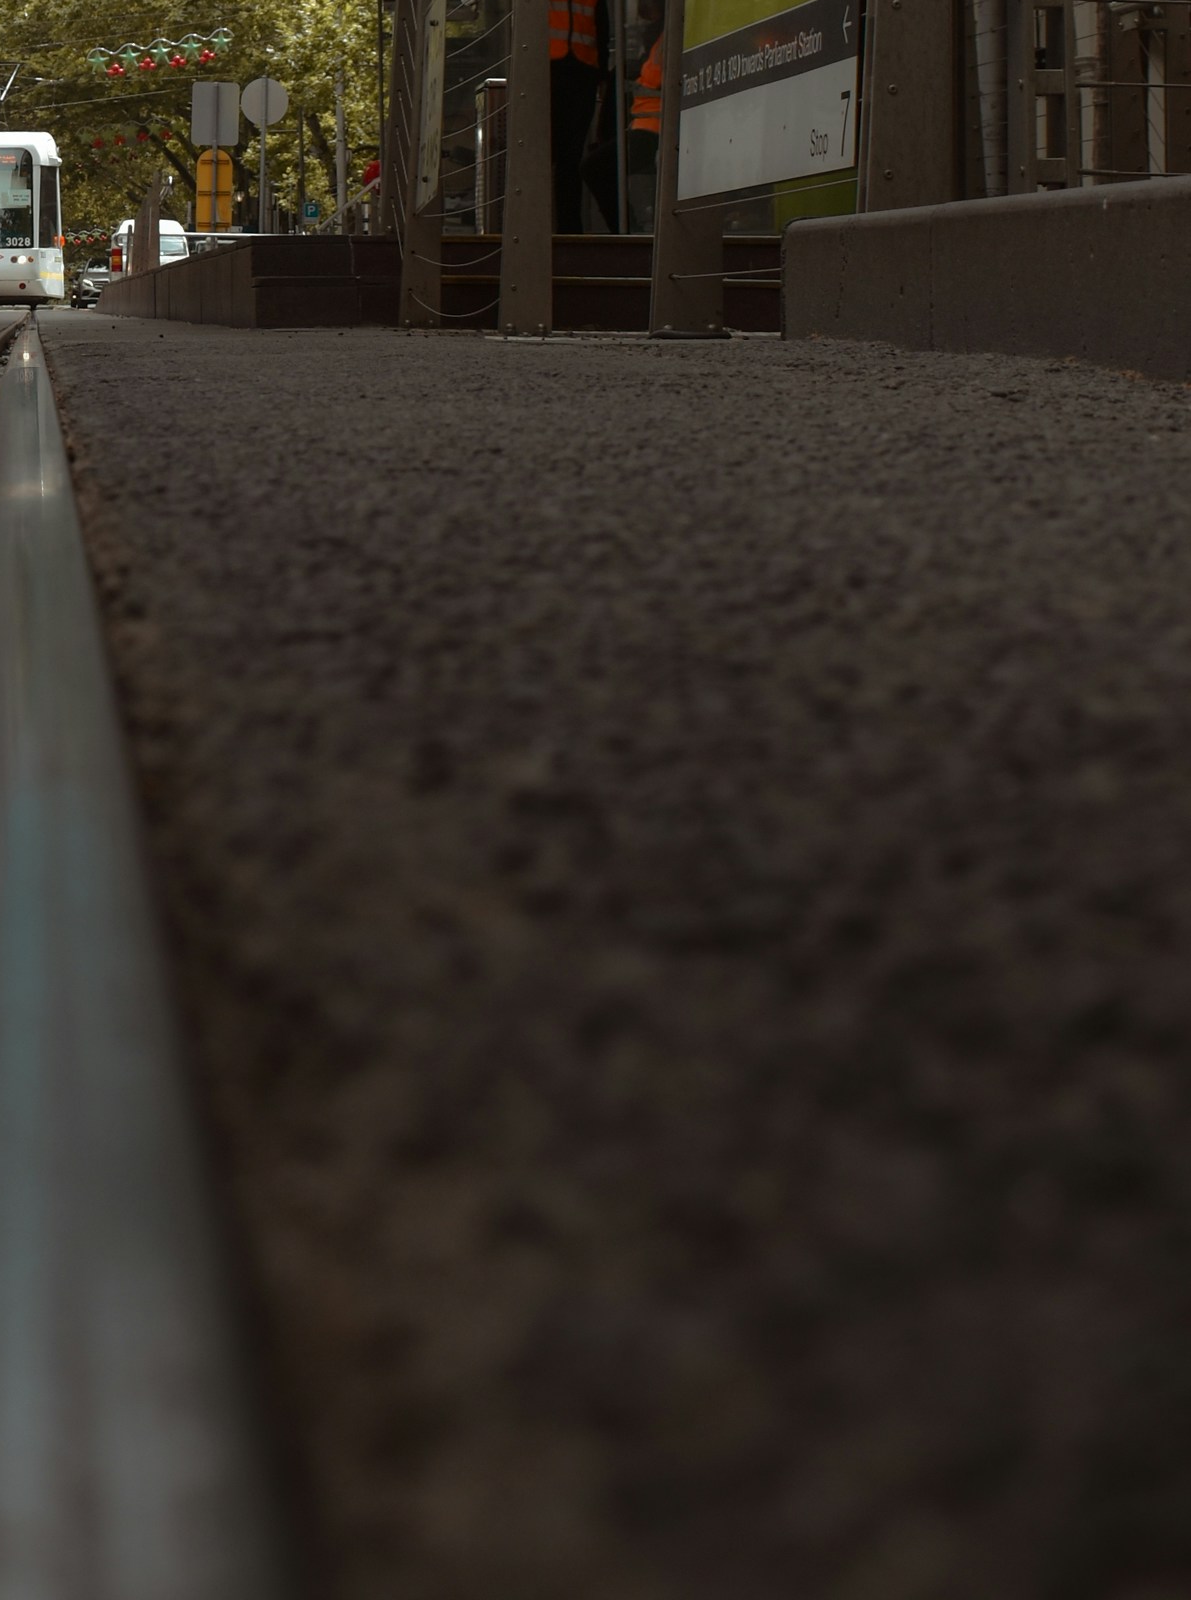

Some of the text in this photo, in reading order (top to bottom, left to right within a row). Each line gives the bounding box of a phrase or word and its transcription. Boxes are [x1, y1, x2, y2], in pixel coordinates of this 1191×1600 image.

[683, 74, 698, 96] Trams
[742, 47, 764, 77] towards
[765, 36, 798, 69] Parliament
[798, 28, 822, 59] Station
[810, 90, 850, 161] Stop 7
[6, 237, 31, 247] 3028
